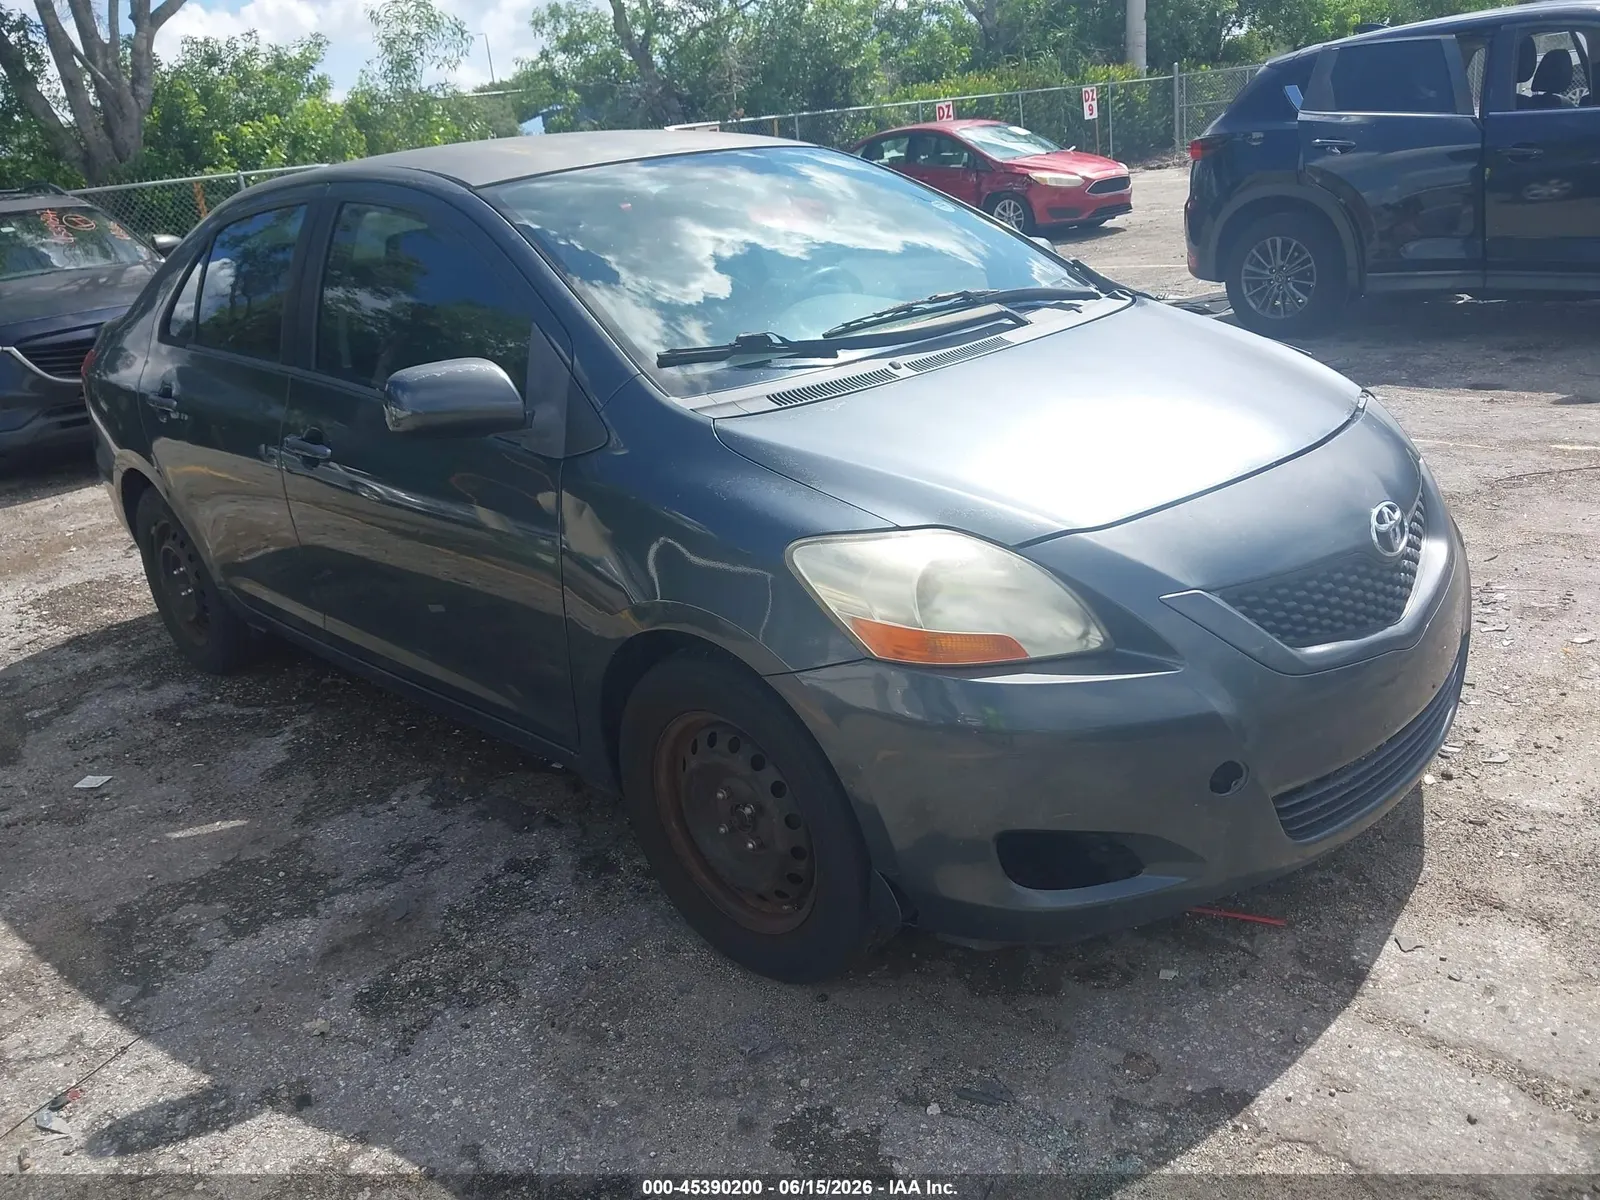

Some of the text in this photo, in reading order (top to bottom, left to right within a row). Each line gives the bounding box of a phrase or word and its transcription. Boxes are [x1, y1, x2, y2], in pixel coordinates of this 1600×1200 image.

[1084, 89, 1096, 103] DZ
[937, 104, 952, 121] DZ
[1087, 103, 1094, 116] 9
